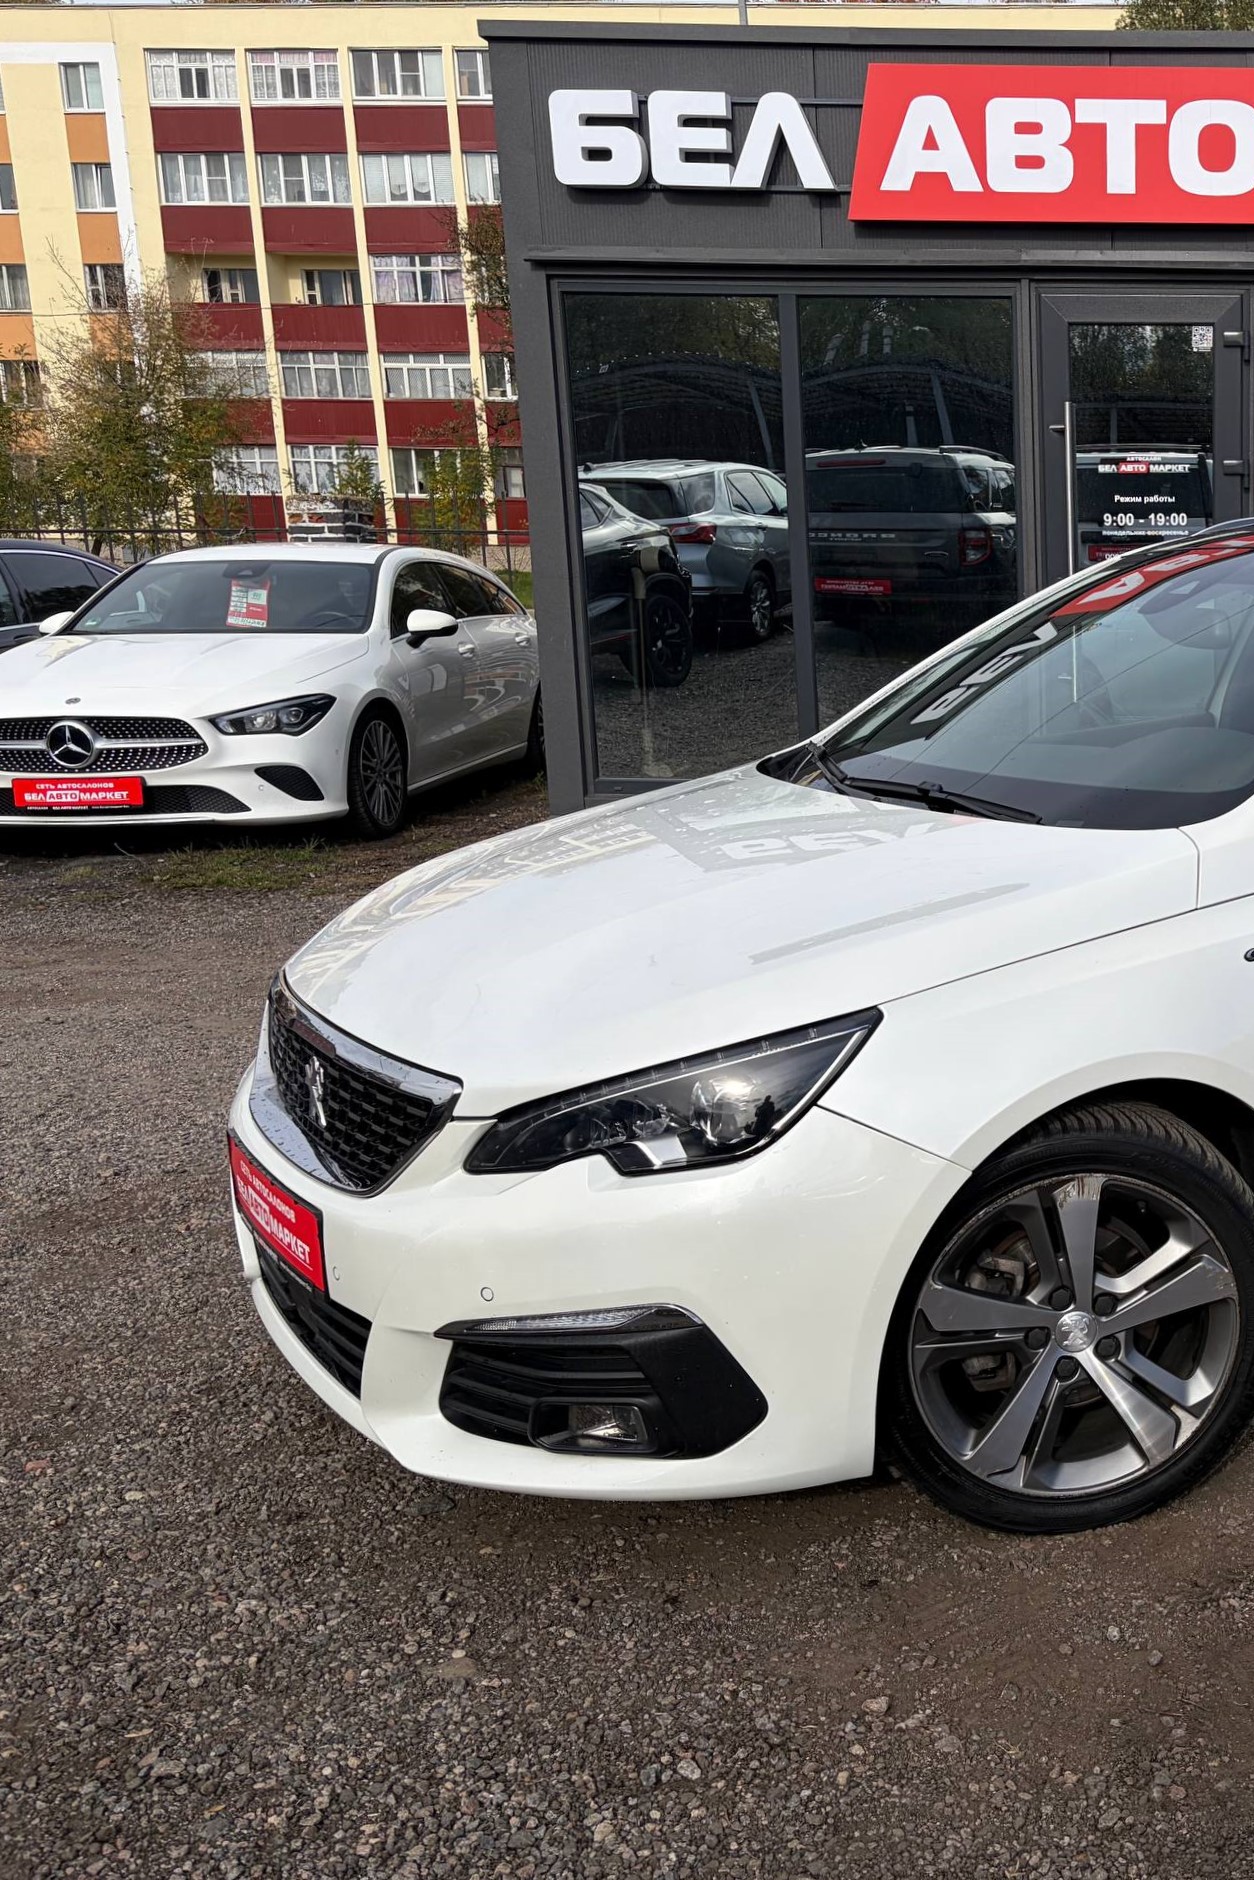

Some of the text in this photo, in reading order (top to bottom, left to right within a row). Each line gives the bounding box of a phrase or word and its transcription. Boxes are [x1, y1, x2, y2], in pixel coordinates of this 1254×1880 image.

[547, 89, 837, 190] БЕЛ
[1098, 464, 1190, 473] БЕЛ АВТО МАРКЕТ
[1114, 494, 1175, 504] Режим работы
[1103, 513, 1135, 526] 9:00
[1148, 512, 1188, 526] 19:00
[24, 791, 129, 802] БЕЛ АВТО МАРКЕТ
[270, 1217, 311, 1264] МАРКЕТ
